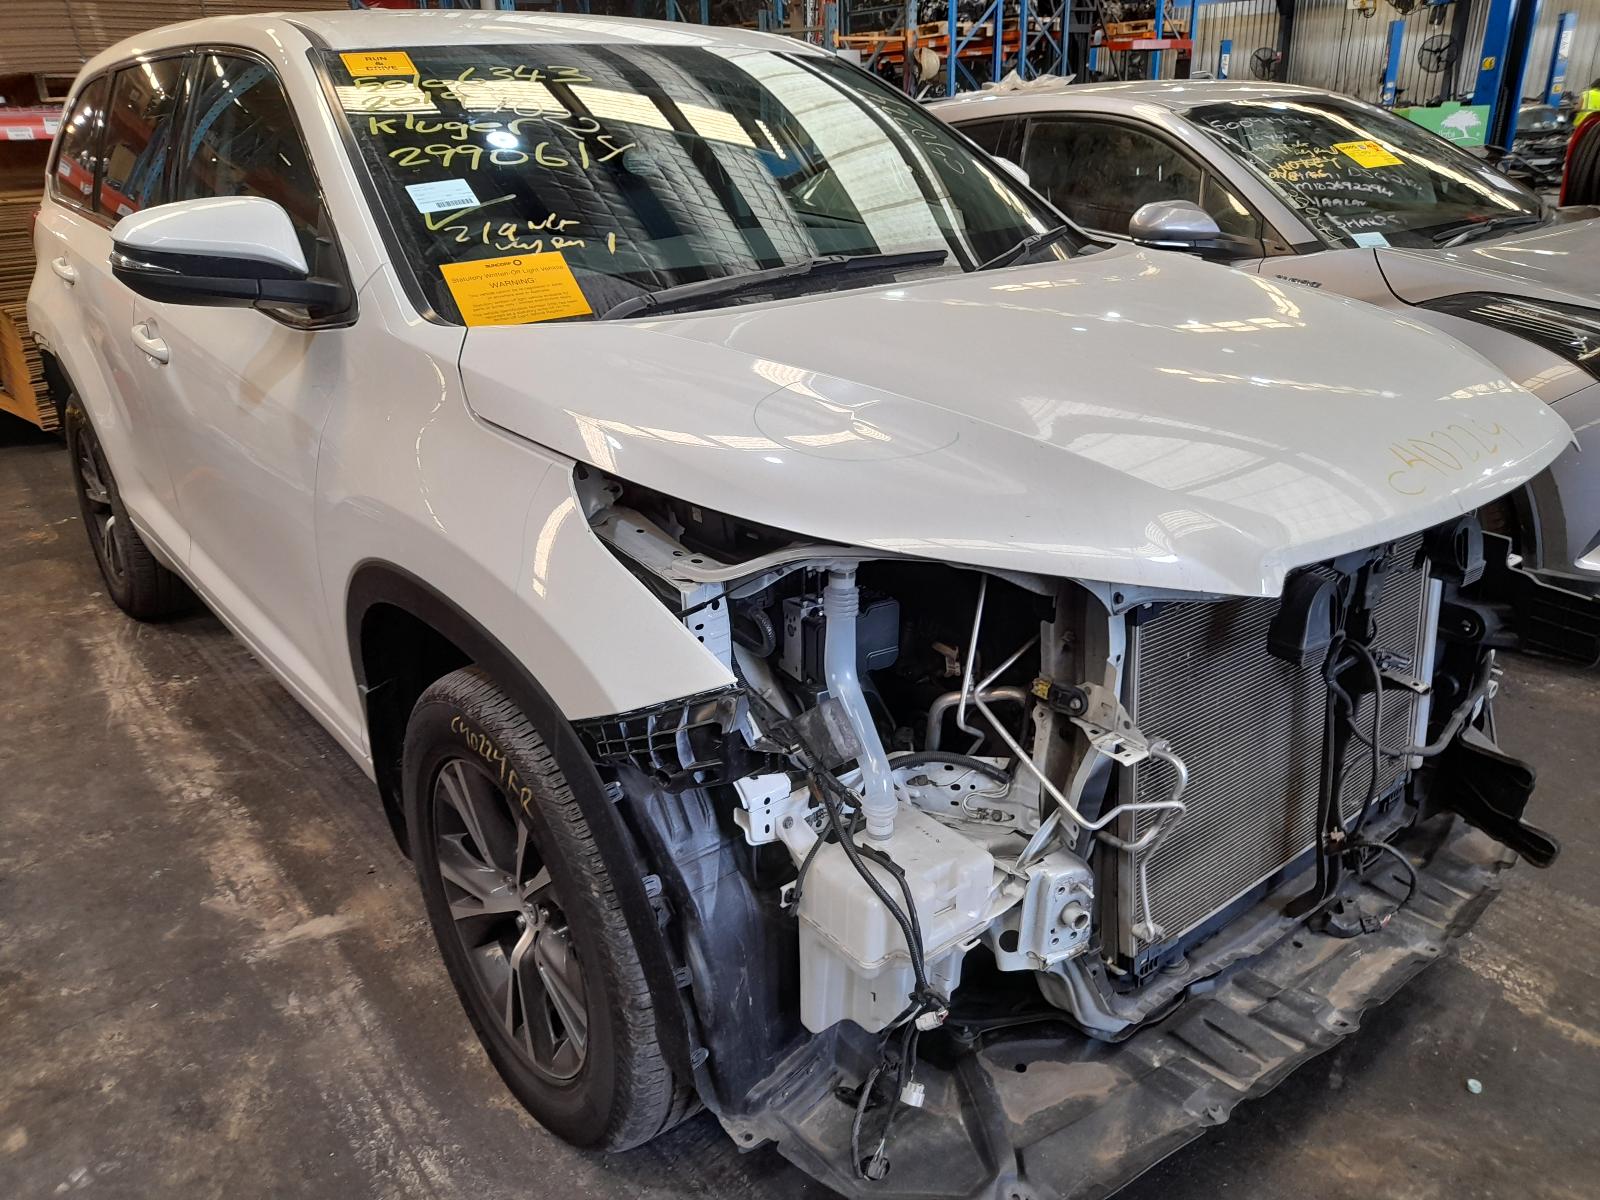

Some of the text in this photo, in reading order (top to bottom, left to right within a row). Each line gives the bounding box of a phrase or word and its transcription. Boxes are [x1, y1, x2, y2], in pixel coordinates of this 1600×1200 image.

[362, 90, 468, 112] 2019
[368, 112, 546, 141] Kluger
[388, 141, 590, 171] 299061
[489, 277, 536, 289] WARNING
